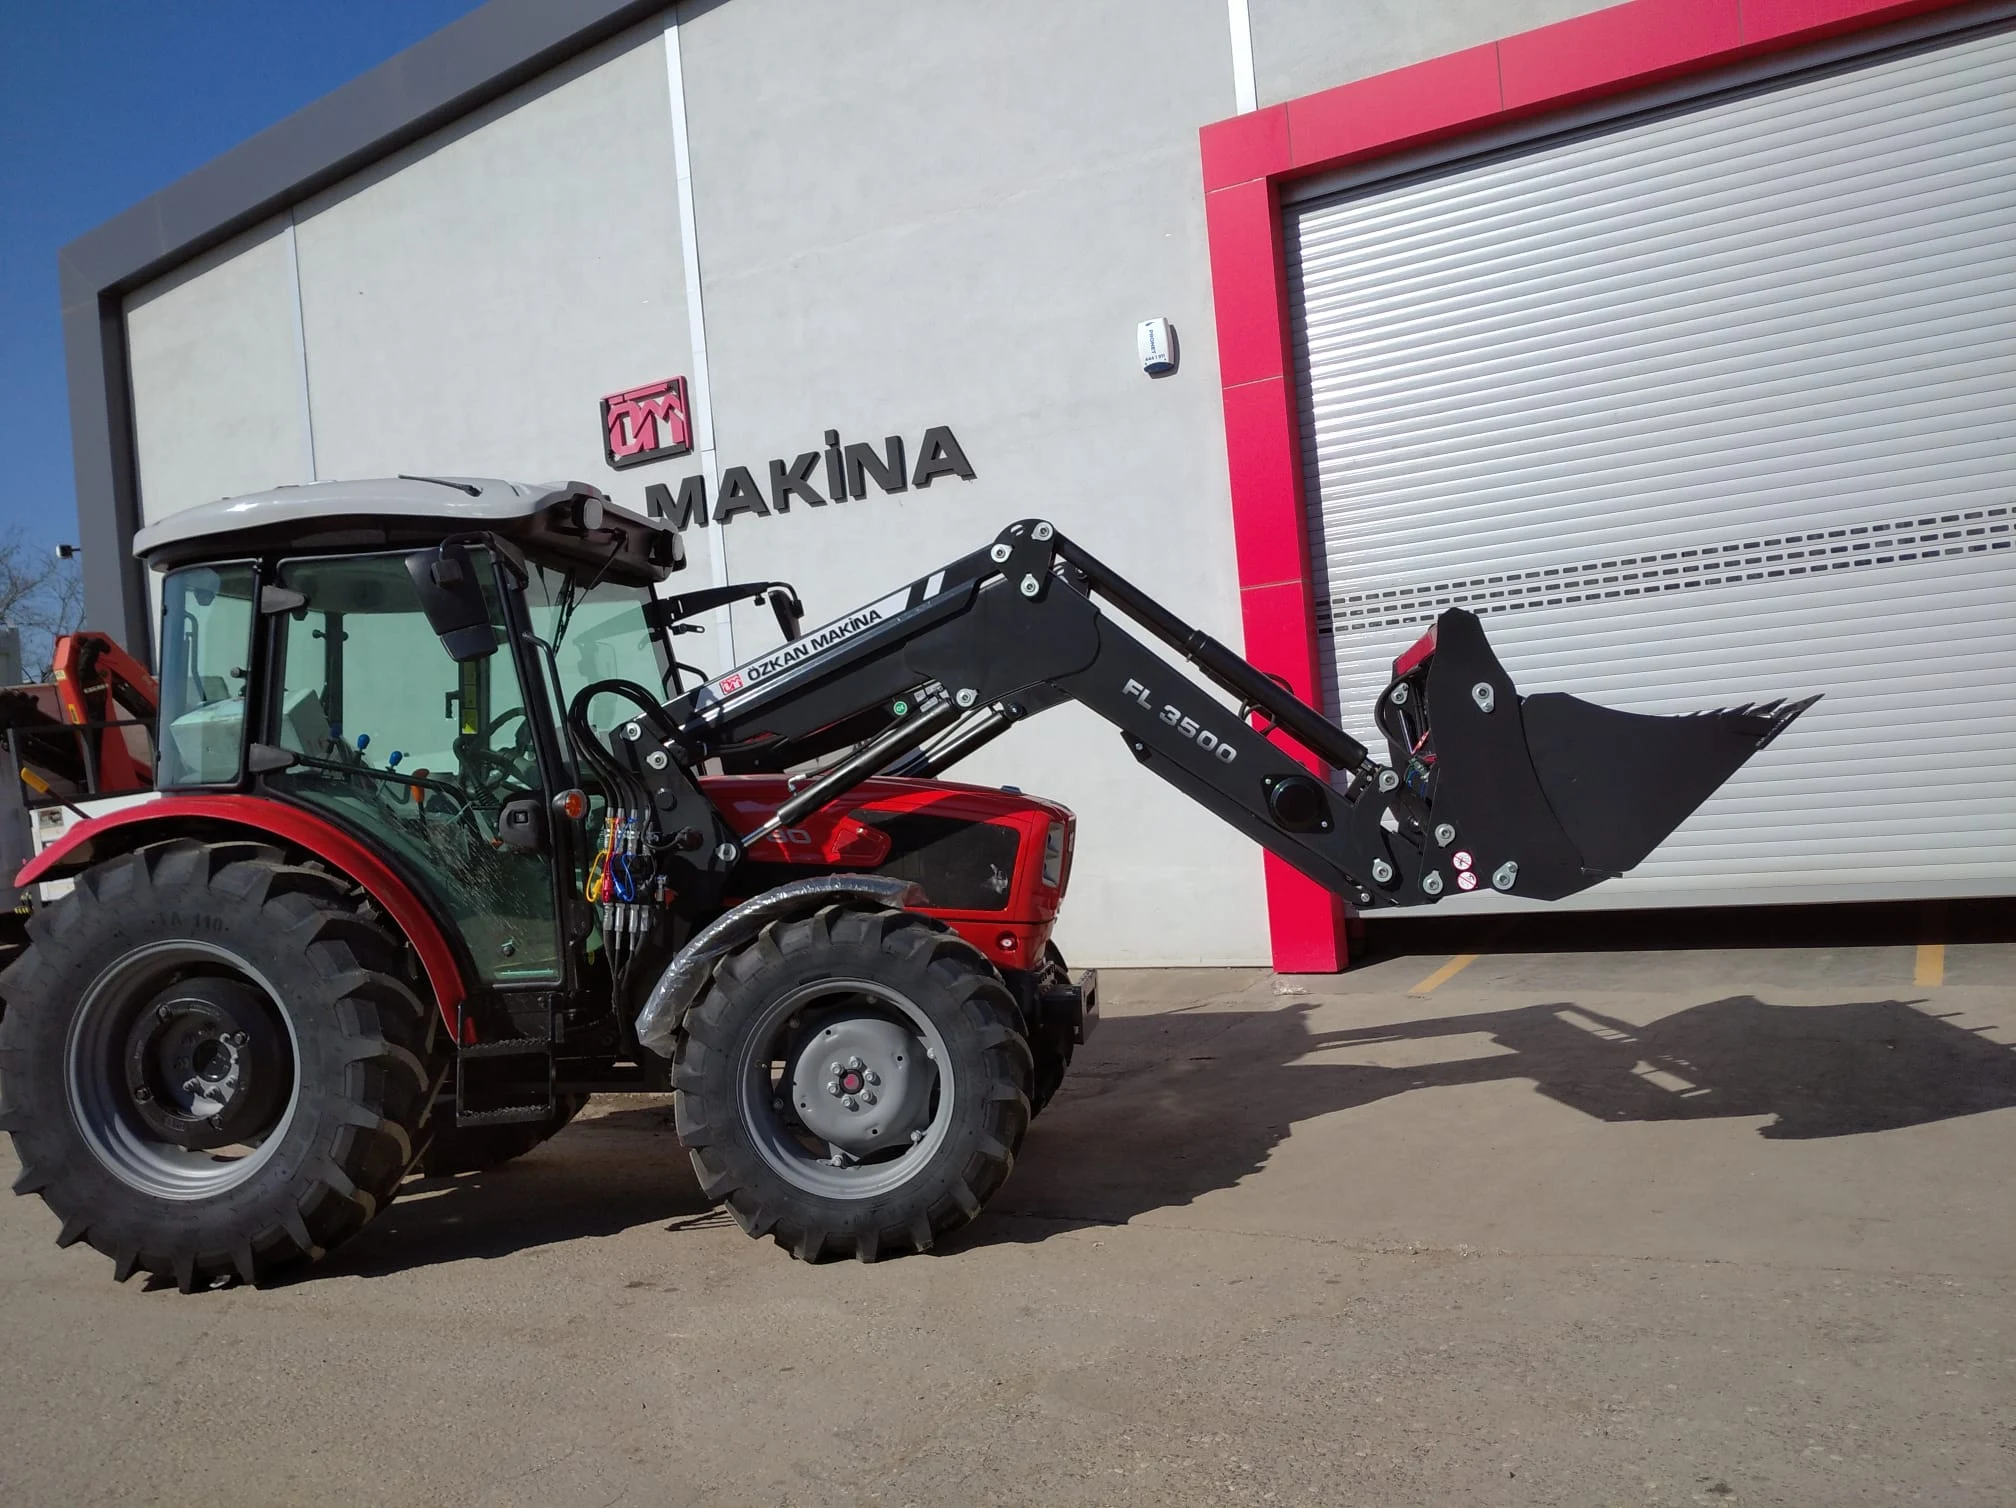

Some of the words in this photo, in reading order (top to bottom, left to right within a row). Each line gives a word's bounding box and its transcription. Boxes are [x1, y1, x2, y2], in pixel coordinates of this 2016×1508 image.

[645, 425, 977, 532] MAKİNA
[747, 644, 809, 681] ÖZKAN
[810, 609, 883, 651] MAKİNA
[1122, 678, 1152, 711] FL
[1159, 704, 1237, 764] 3500
